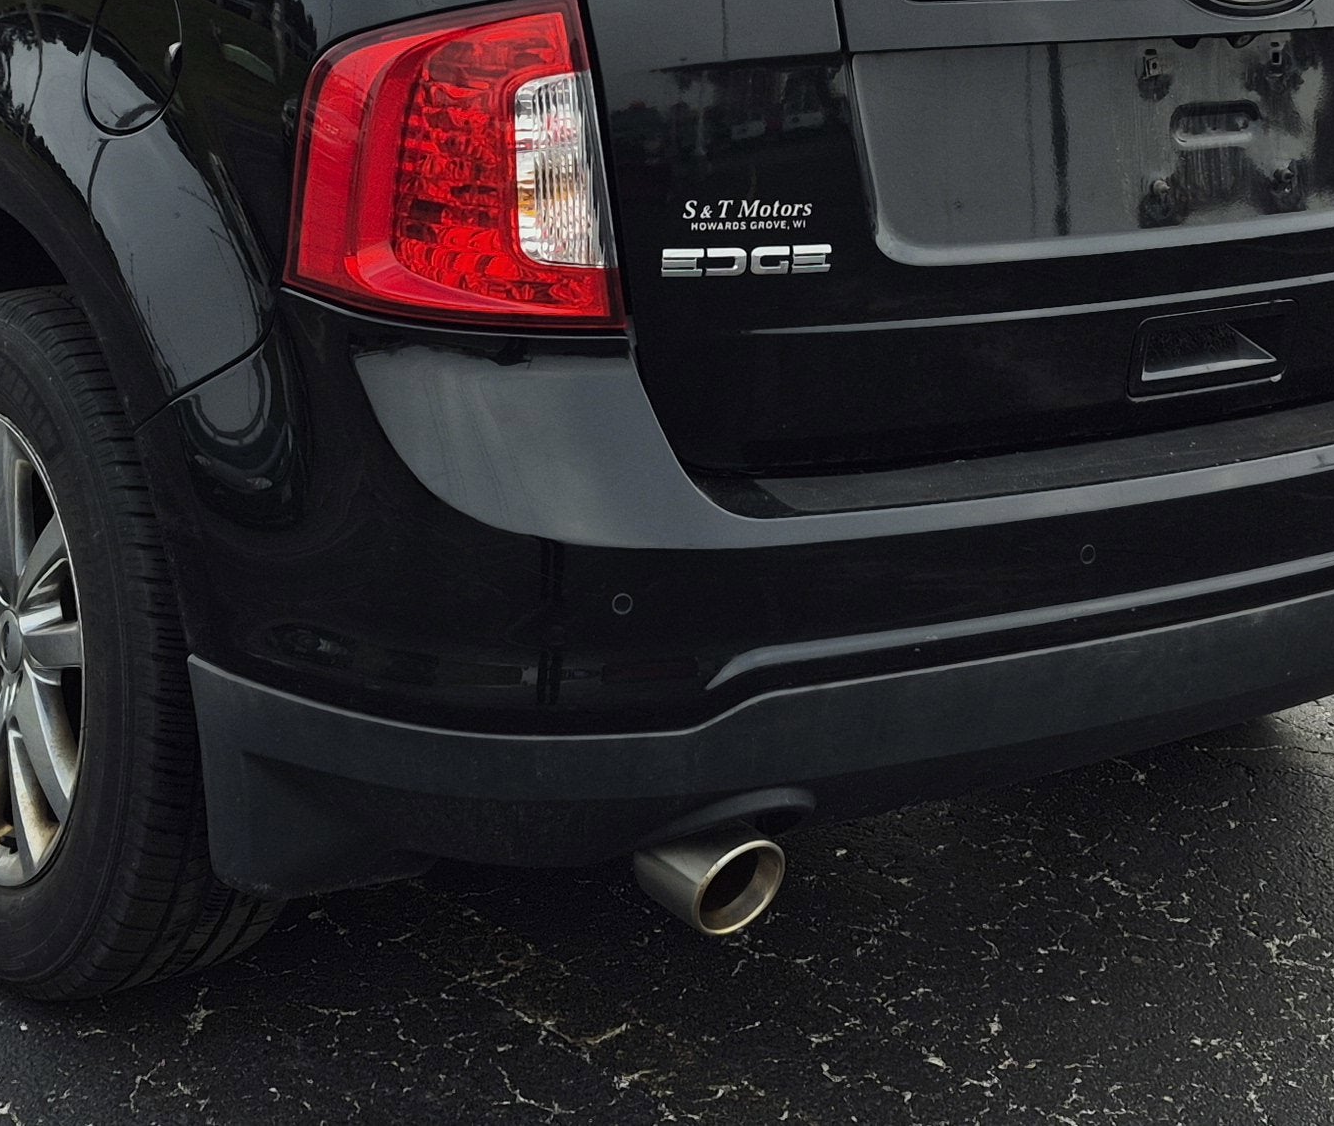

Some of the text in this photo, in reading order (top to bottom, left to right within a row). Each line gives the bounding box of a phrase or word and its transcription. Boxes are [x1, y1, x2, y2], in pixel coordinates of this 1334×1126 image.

[682, 199, 813, 220] S & T Motors
[690, 219, 807, 232] HOWARDS GROVE, WI
[661, 244, 833, 278] EDGE
